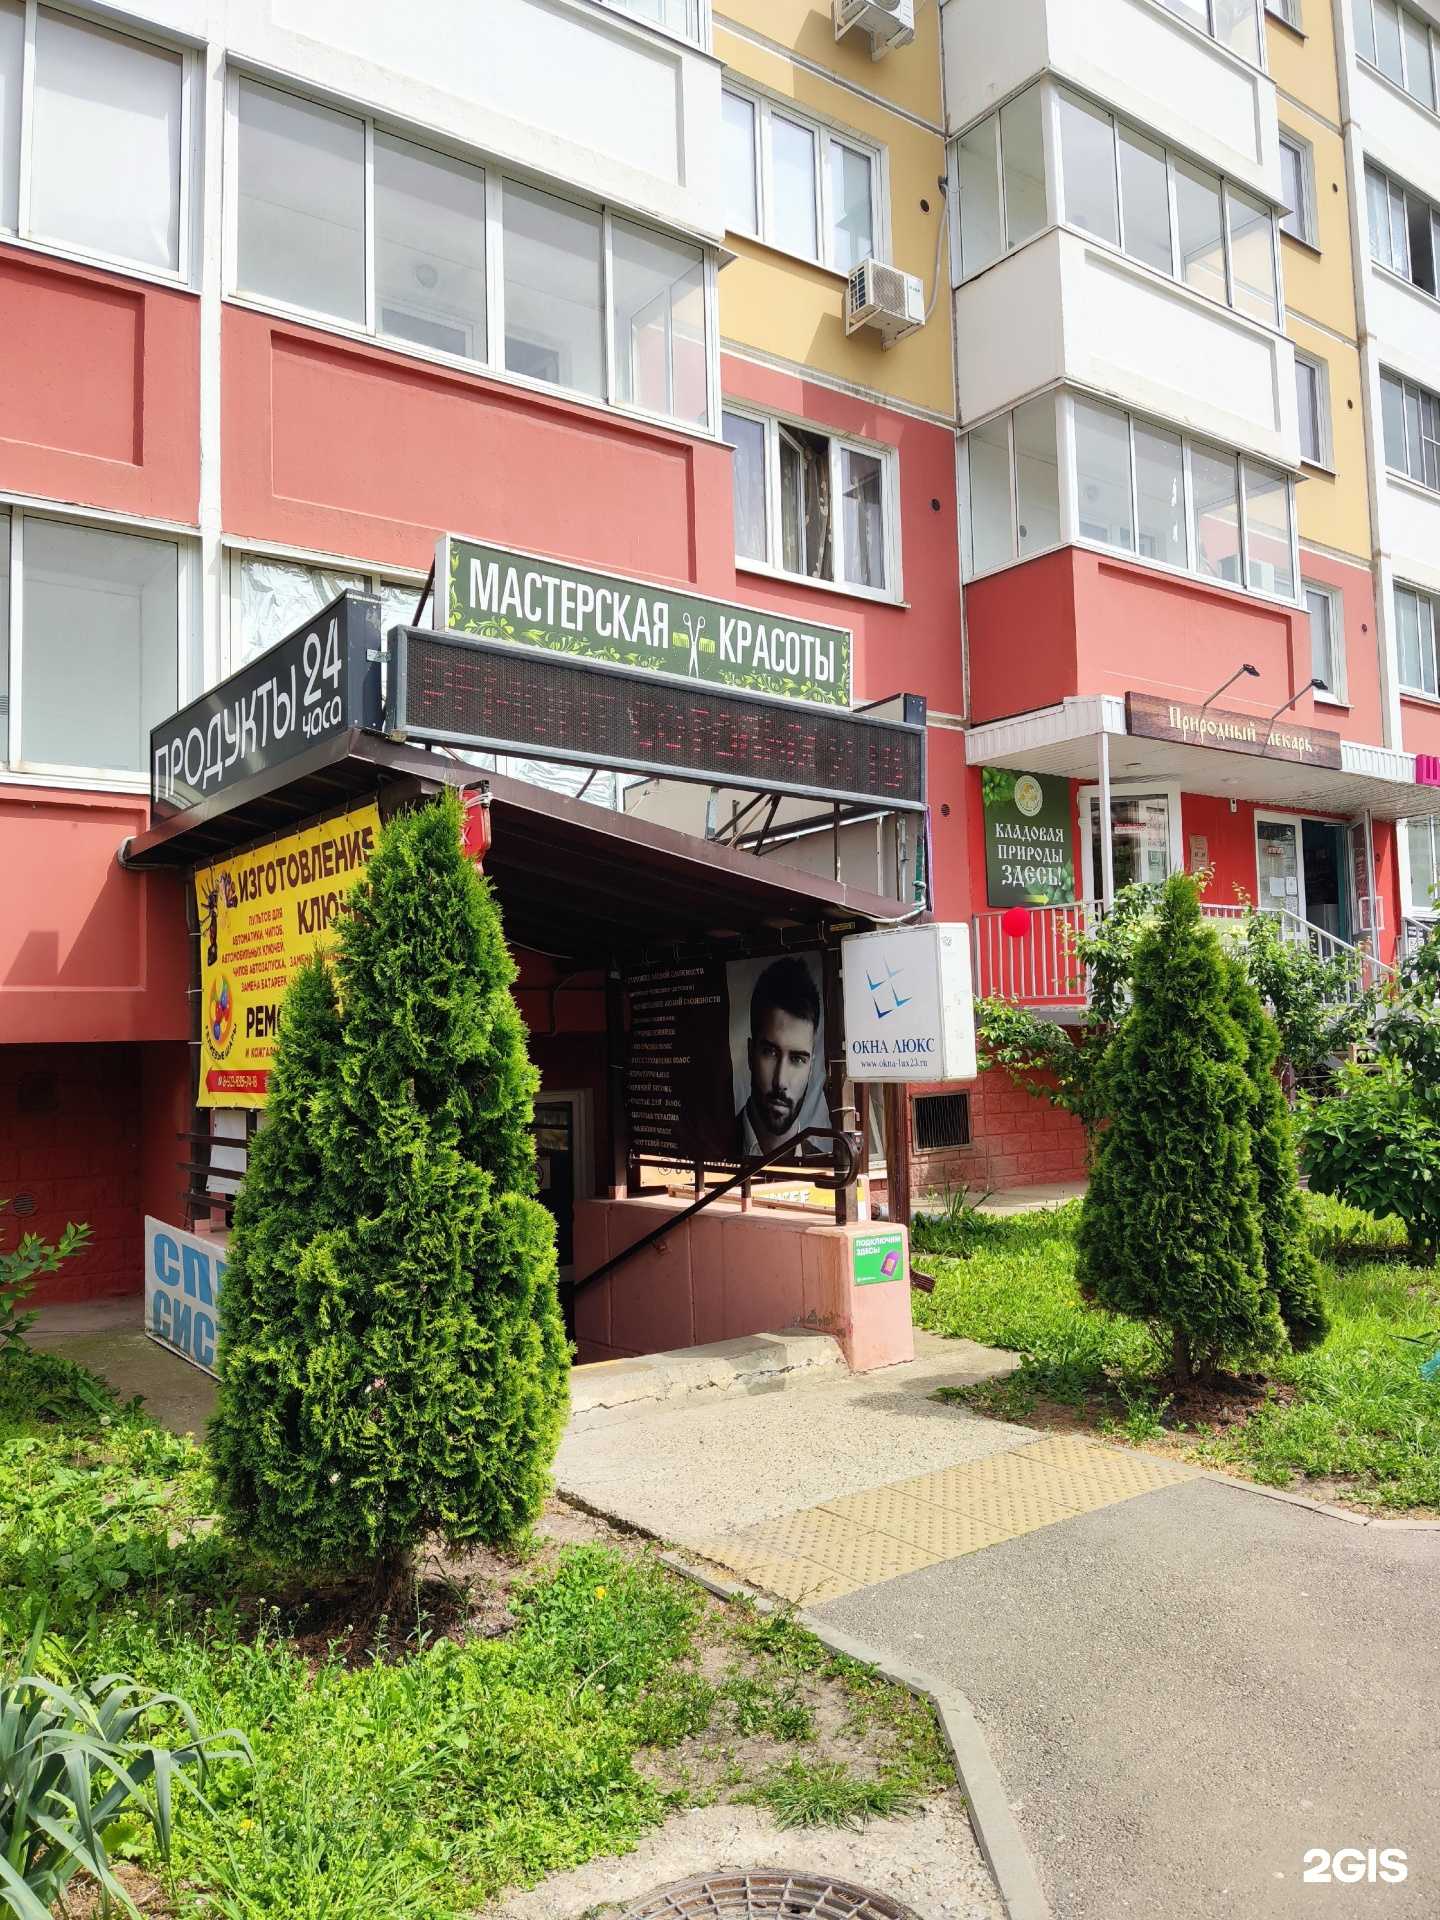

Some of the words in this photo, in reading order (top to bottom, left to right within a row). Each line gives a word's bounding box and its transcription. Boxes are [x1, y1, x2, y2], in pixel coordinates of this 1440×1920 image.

[469, 558, 669, 650] МАСТЕРСКАЯ
[719, 615, 835, 683] КРАСОТЫ
[155, 665, 296, 803] ПРОДУКТЫ
[302, 617, 342, 706] 24
[1169, 705, 1256, 744] Природный
[995, 823, 1064, 843] КЛАДОВАЯ
[238, 826, 374, 903] ИЗГОТОВЛЕНИЕ
[998, 844, 1063, 864] ПРИРОДЫ
[1002, 864, 1062, 888] ЗДЕСЬ!
[297, 883, 369, 935] КЛЮЧ
[852, 1039, 889, 1054] ОКНА
[892, 1038, 935, 1053] ЛЮКС
[860, 1058, 928, 1069] www.okna-lux23.ru
[153, 1290, 218, 1367] СИС
